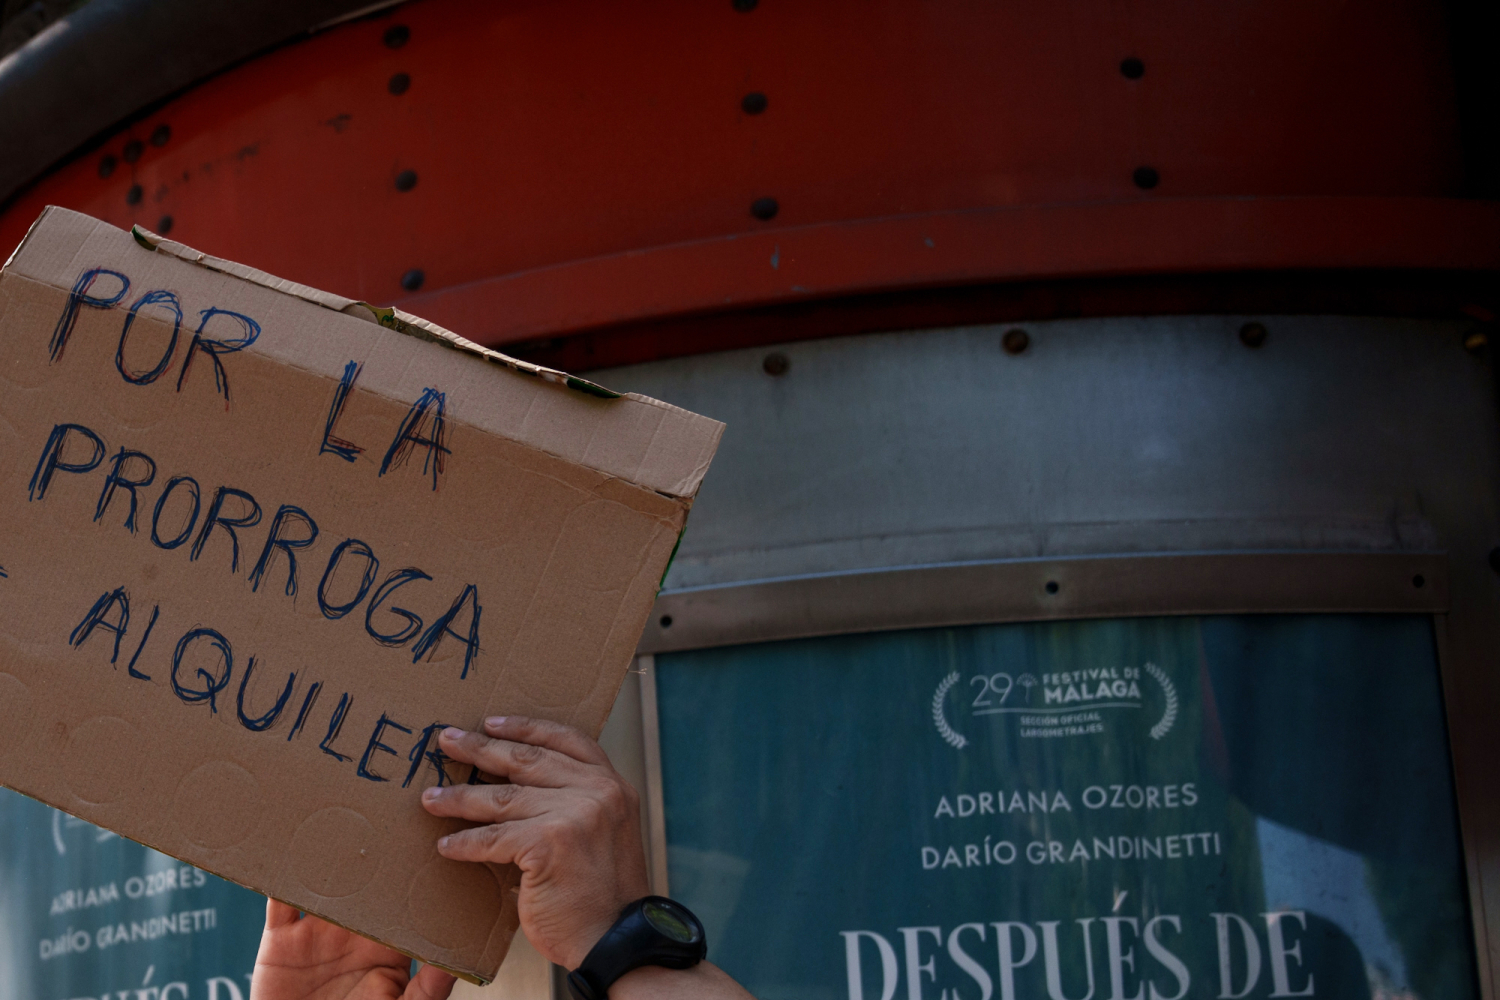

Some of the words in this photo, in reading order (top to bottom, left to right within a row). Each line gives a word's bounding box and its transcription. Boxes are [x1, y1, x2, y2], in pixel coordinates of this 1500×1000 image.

[49, 268, 262, 408] POR
[319, 360, 452, 490] LA
[28, 422, 482, 679] PRORROGA
[1042, 667, 1119, 686] FESTIVAL
[1124, 666, 1140, 680] DE
[1060, 711, 1101, 723] OFICIAL
[933, 787, 1072, 820] ADRIANA
[1081, 782, 1199, 812] OZORES
[921, 835, 1017, 872] DARÍO
[1025, 831, 1222, 865] GRANDINETTI
[125, 865, 208, 899] OZORES
